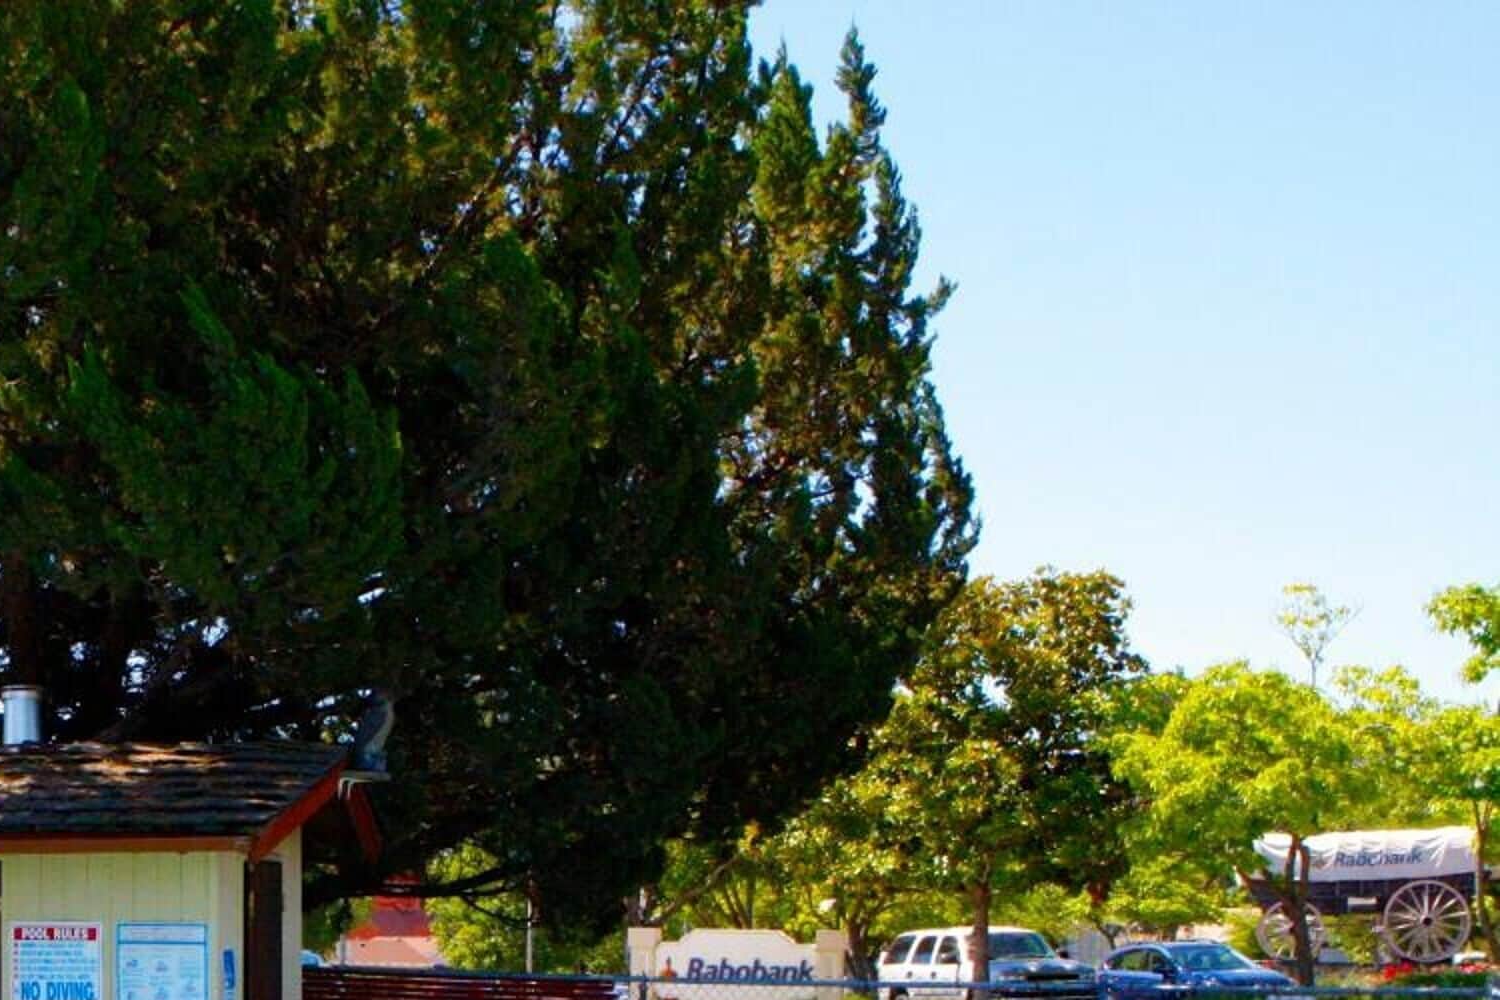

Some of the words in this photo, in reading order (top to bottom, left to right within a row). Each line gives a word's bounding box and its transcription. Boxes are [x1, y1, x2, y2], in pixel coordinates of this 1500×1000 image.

[22, 927, 46, 940] POOL
[54, 927, 87, 940] RULES
[686, 957, 813, 981] Rabobank
[21, 981, 41, 1000] NO
